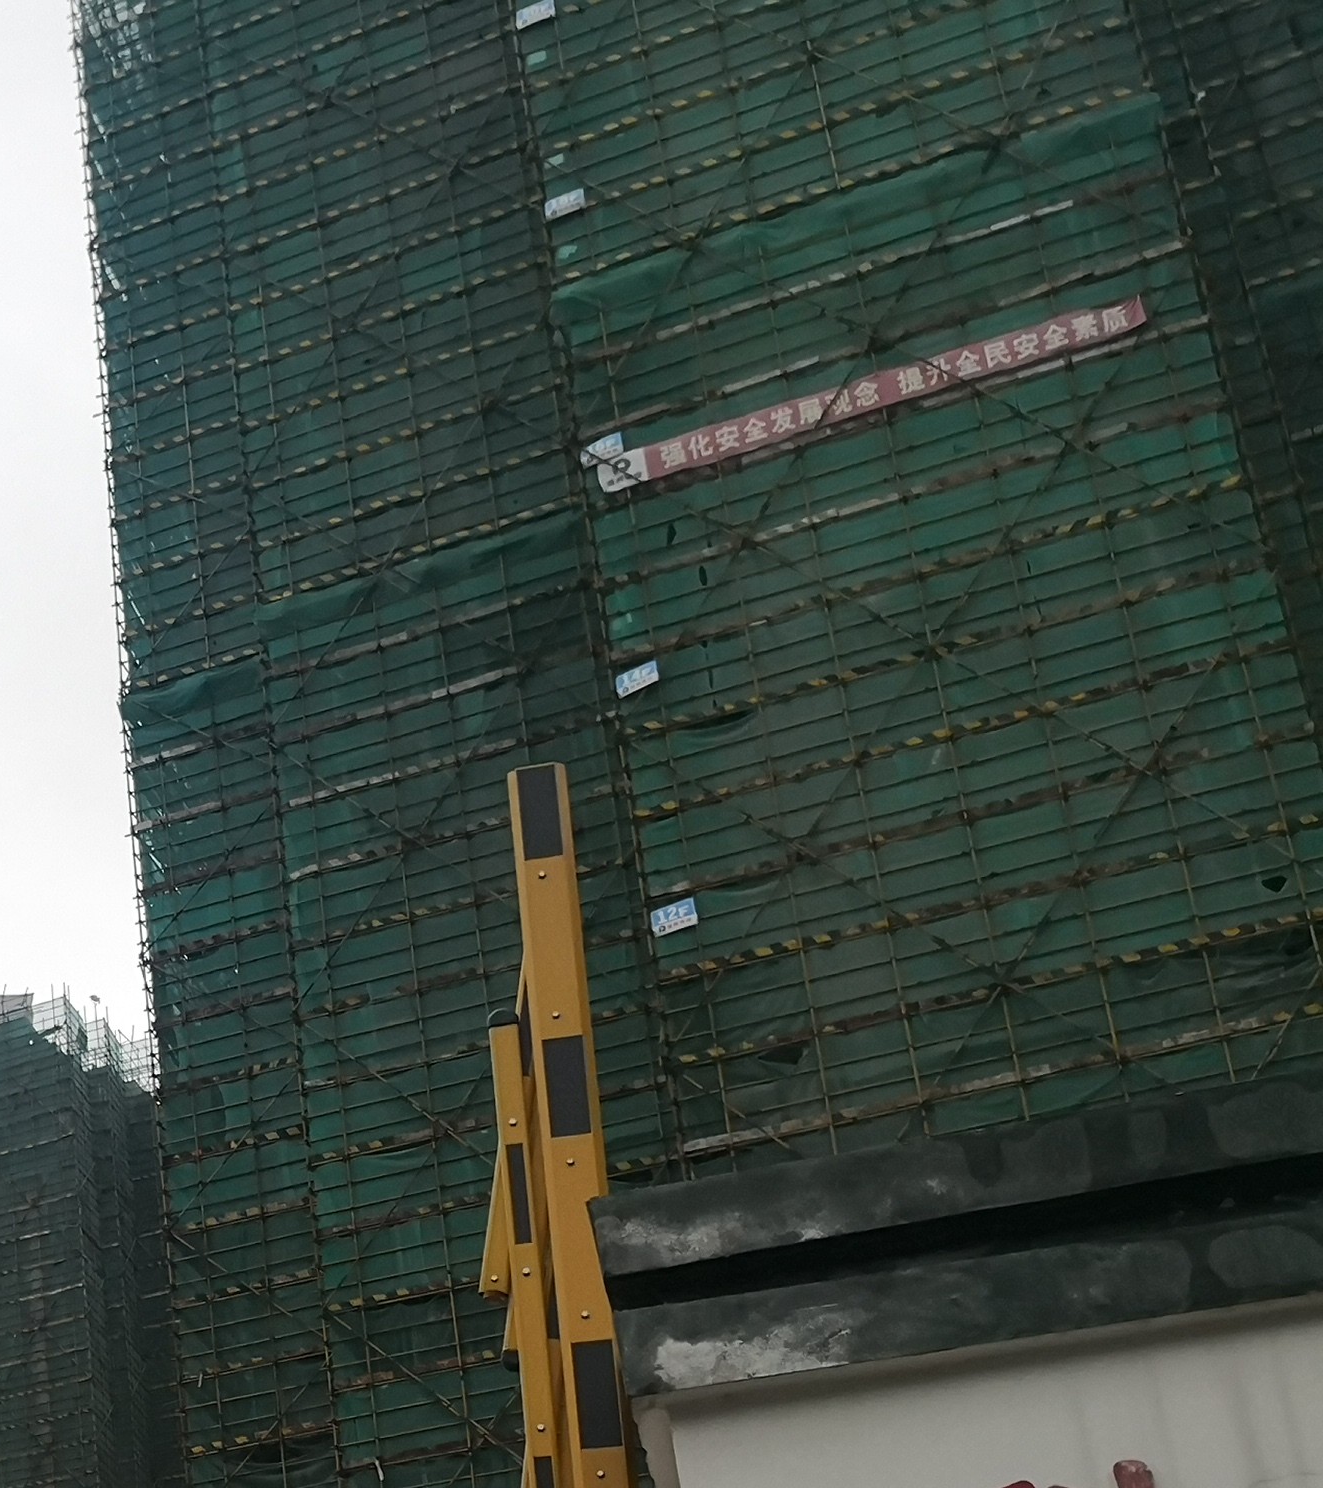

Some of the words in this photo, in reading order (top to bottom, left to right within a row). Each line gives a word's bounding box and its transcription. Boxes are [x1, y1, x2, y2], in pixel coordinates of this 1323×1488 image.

[660, 381, 880, 469] 强化安全发展观念
[897, 305, 1129, 396] 提升全民安全素质
[657, 904, 690, 924] 12F
